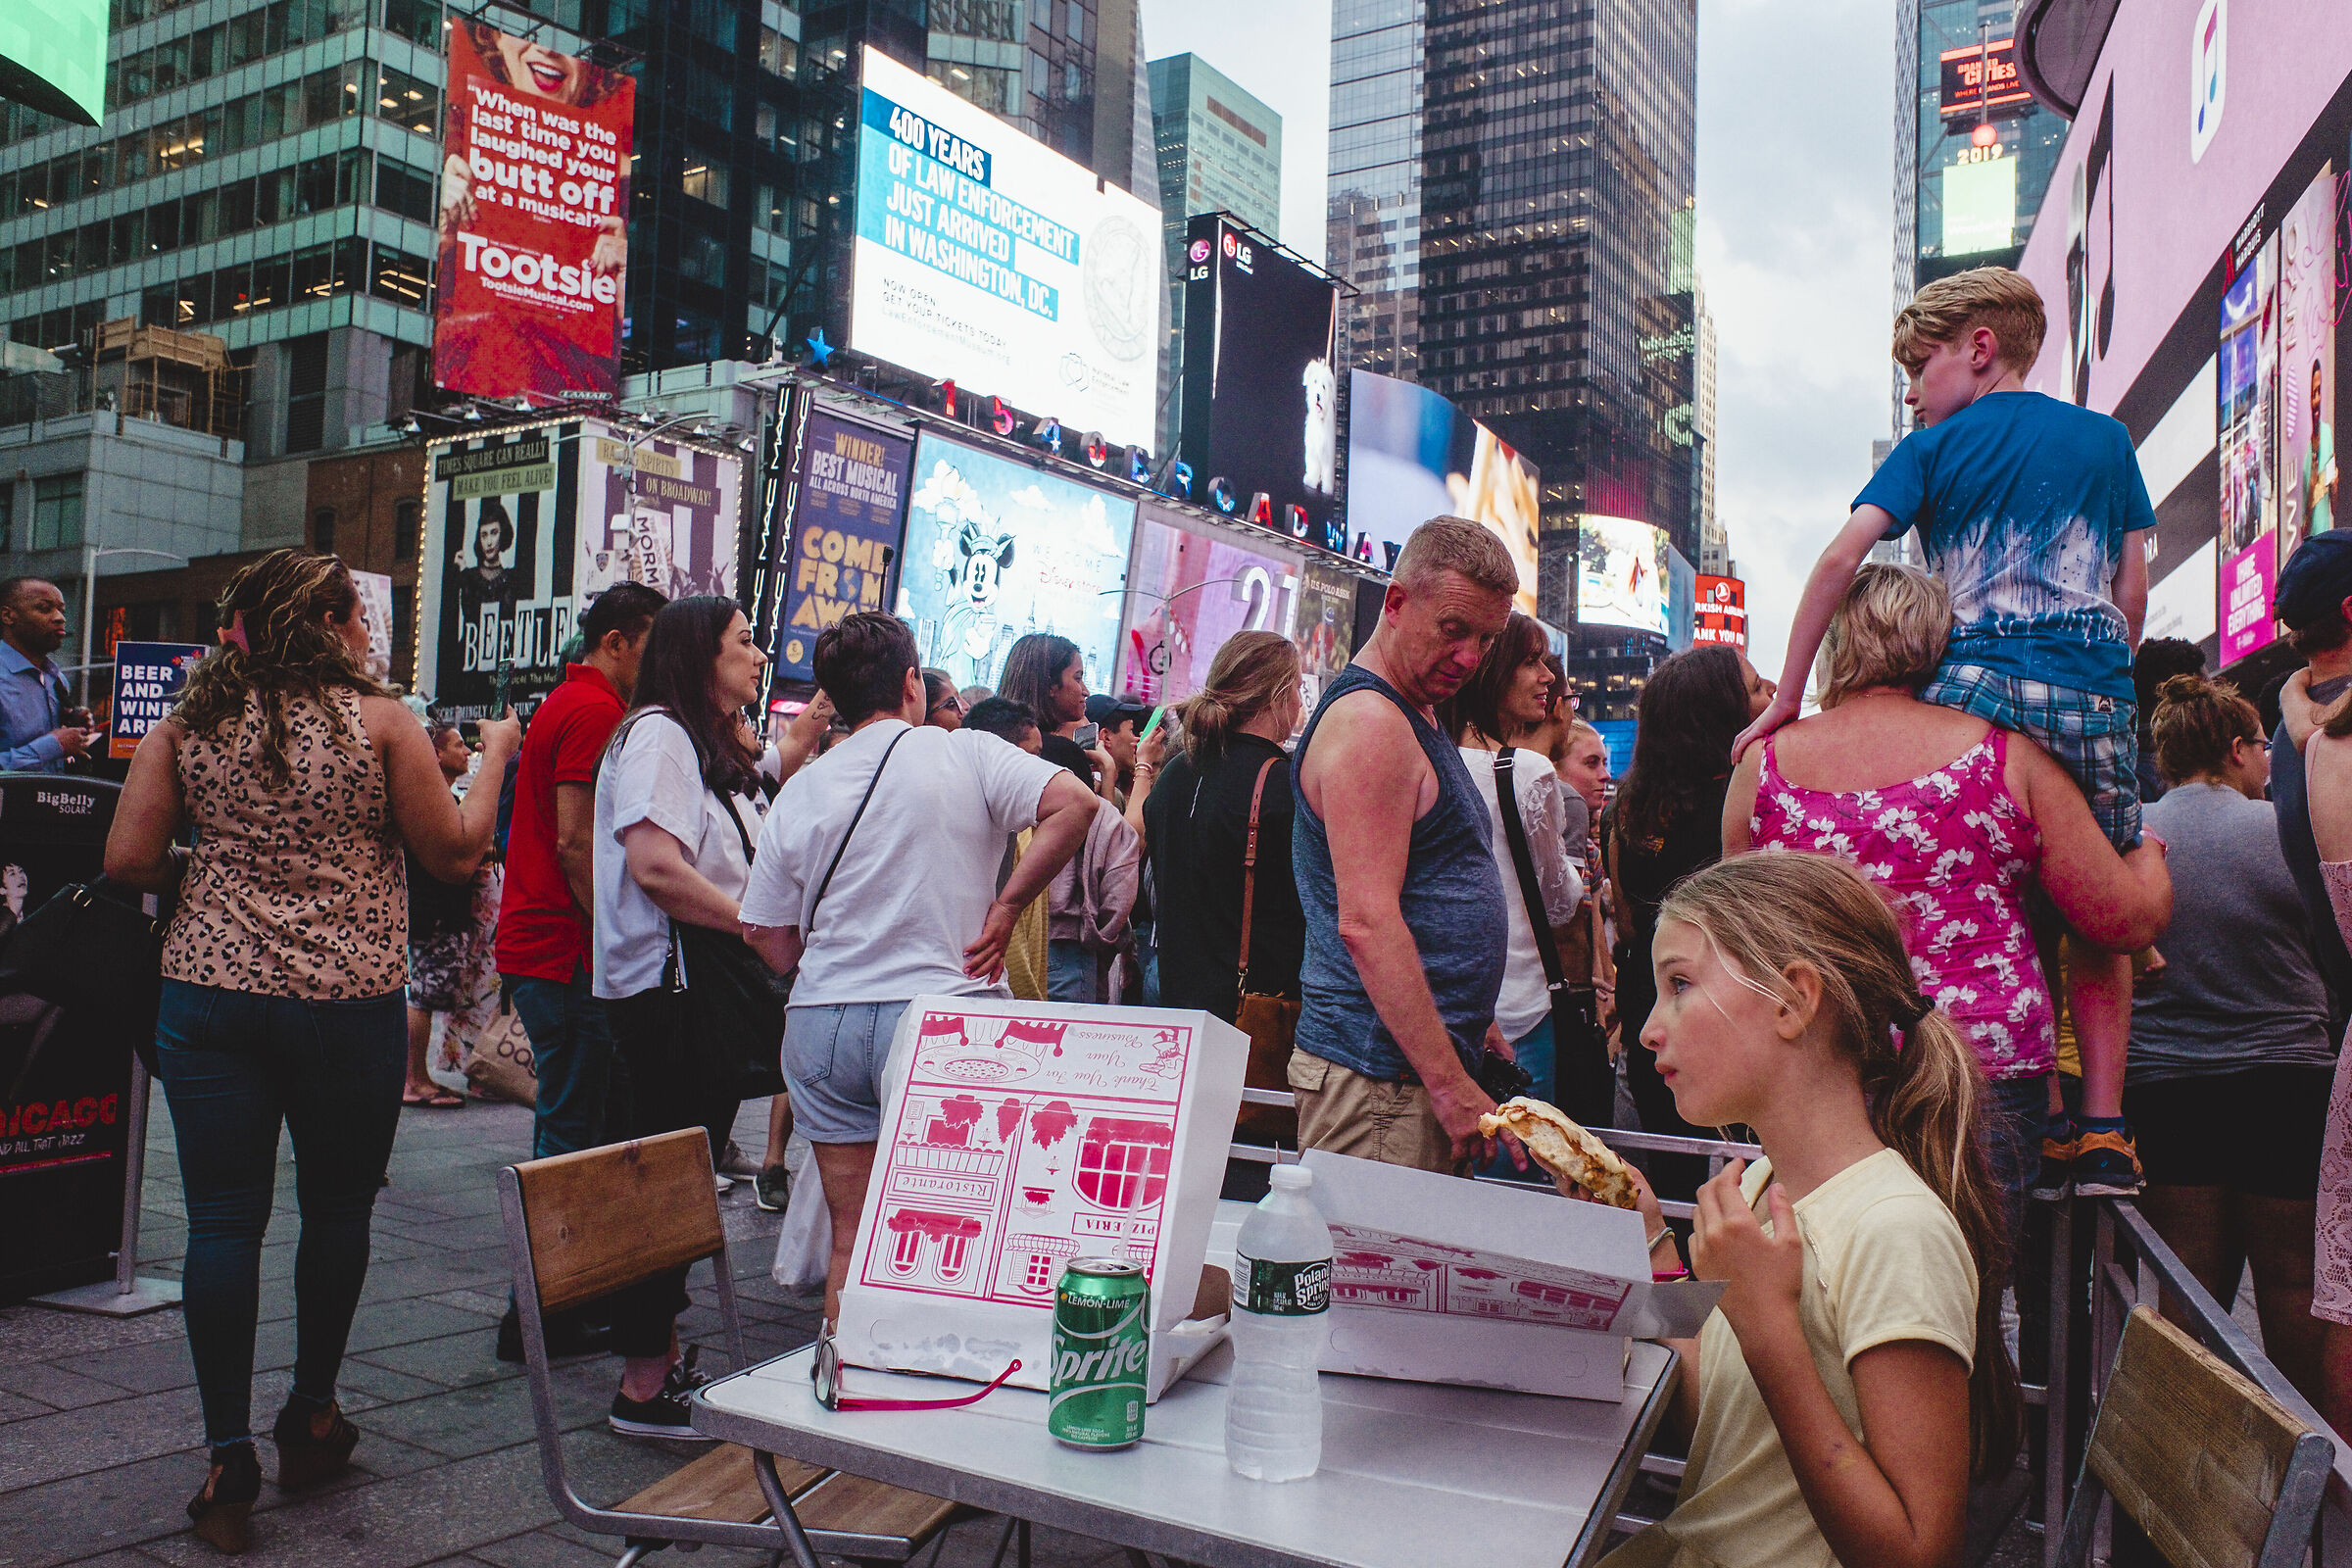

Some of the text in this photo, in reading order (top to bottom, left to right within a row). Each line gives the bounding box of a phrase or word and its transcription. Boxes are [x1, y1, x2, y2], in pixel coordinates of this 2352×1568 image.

[1957, 58, 1999, 74] BRANED
[1978, 82, 2006, 94] BANDS
[472, 104, 616, 165] last time you
[541, 111, 580, 134] was
[584, 122, 616, 145] the
[470, 126, 615, 183] laughed your
[889, 106, 984, 181] 400 YEARS
[1957, 143, 2003, 165] 2019
[469, 147, 615, 215] butt off
[475, 185, 497, 202] at
[501, 192, 514, 207] a
[888, 142, 1075, 260] OF LAW ENFORCEMENT
[886, 180, 1010, 263] JUST ARRIVED
[2235, 202, 2265, 253] MARRIOTT
[1236, 241, 1252, 265] LG
[2235, 227, 2262, 272] MARQUIS
[457, 231, 616, 304] Tootsie
[885, 214, 1053, 318] IN WASHINGTON, DC.
[1189, 265, 1209, 281] LG
[480, 276, 594, 312] TootsieMusical.com
[883, 277, 906, 294] NOW
[883, 291, 902, 306] GET
[906, 301, 933, 317] YOUR
[936, 313, 975, 337] TICKETS
[439, 440, 547, 474] TIMES SQUARE CAN REALLY
[836, 431, 886, 467] WINNER!
[642, 454, 674, 476] SPIRITS
[811, 450, 899, 497] BEST MUSICAL
[457, 468, 553, 495] MAKE YOU FEEL ALIVE!
[646, 477, 711, 507] ON BROADWAY!
[808, 475, 822, 489] ALL
[823, 478, 849, 497] ACROSS
[850, 486, 870, 503] NORTH
[870, 491, 898, 510] AMERICA
[803, 526, 891, 574] COME
[1320, 583, 1335, 595] POLO
[2230, 572, 2263, 612] UNLIMITED
[2228, 594, 2266, 637] EVERYTHING
[1719, 629, 1735, 643] YOU
[121, 664, 173, 681] BEER
[121, 682, 164, 698] AND
[120, 701, 172, 716] WINE
[36, 791, 96, 808] BigBelly
[59, 805, 86, 814] SOLAR
[1078, 1031, 1143, 1049] Business
[1086, 1050, 1126, 1067] Your
[1046, 1069, 1159, 1091] Thank You For
[15, 1141, 30, 1153] ALL
[32, 1136, 56, 1151] THAT
[58, 1134, 85, 1149] JAZZ
[903, 1175, 988, 1198] Ristorante
[1067, 1294, 1130, 1309] LEMON-LIME
[1051, 1334, 1149, 1388] Sprite
